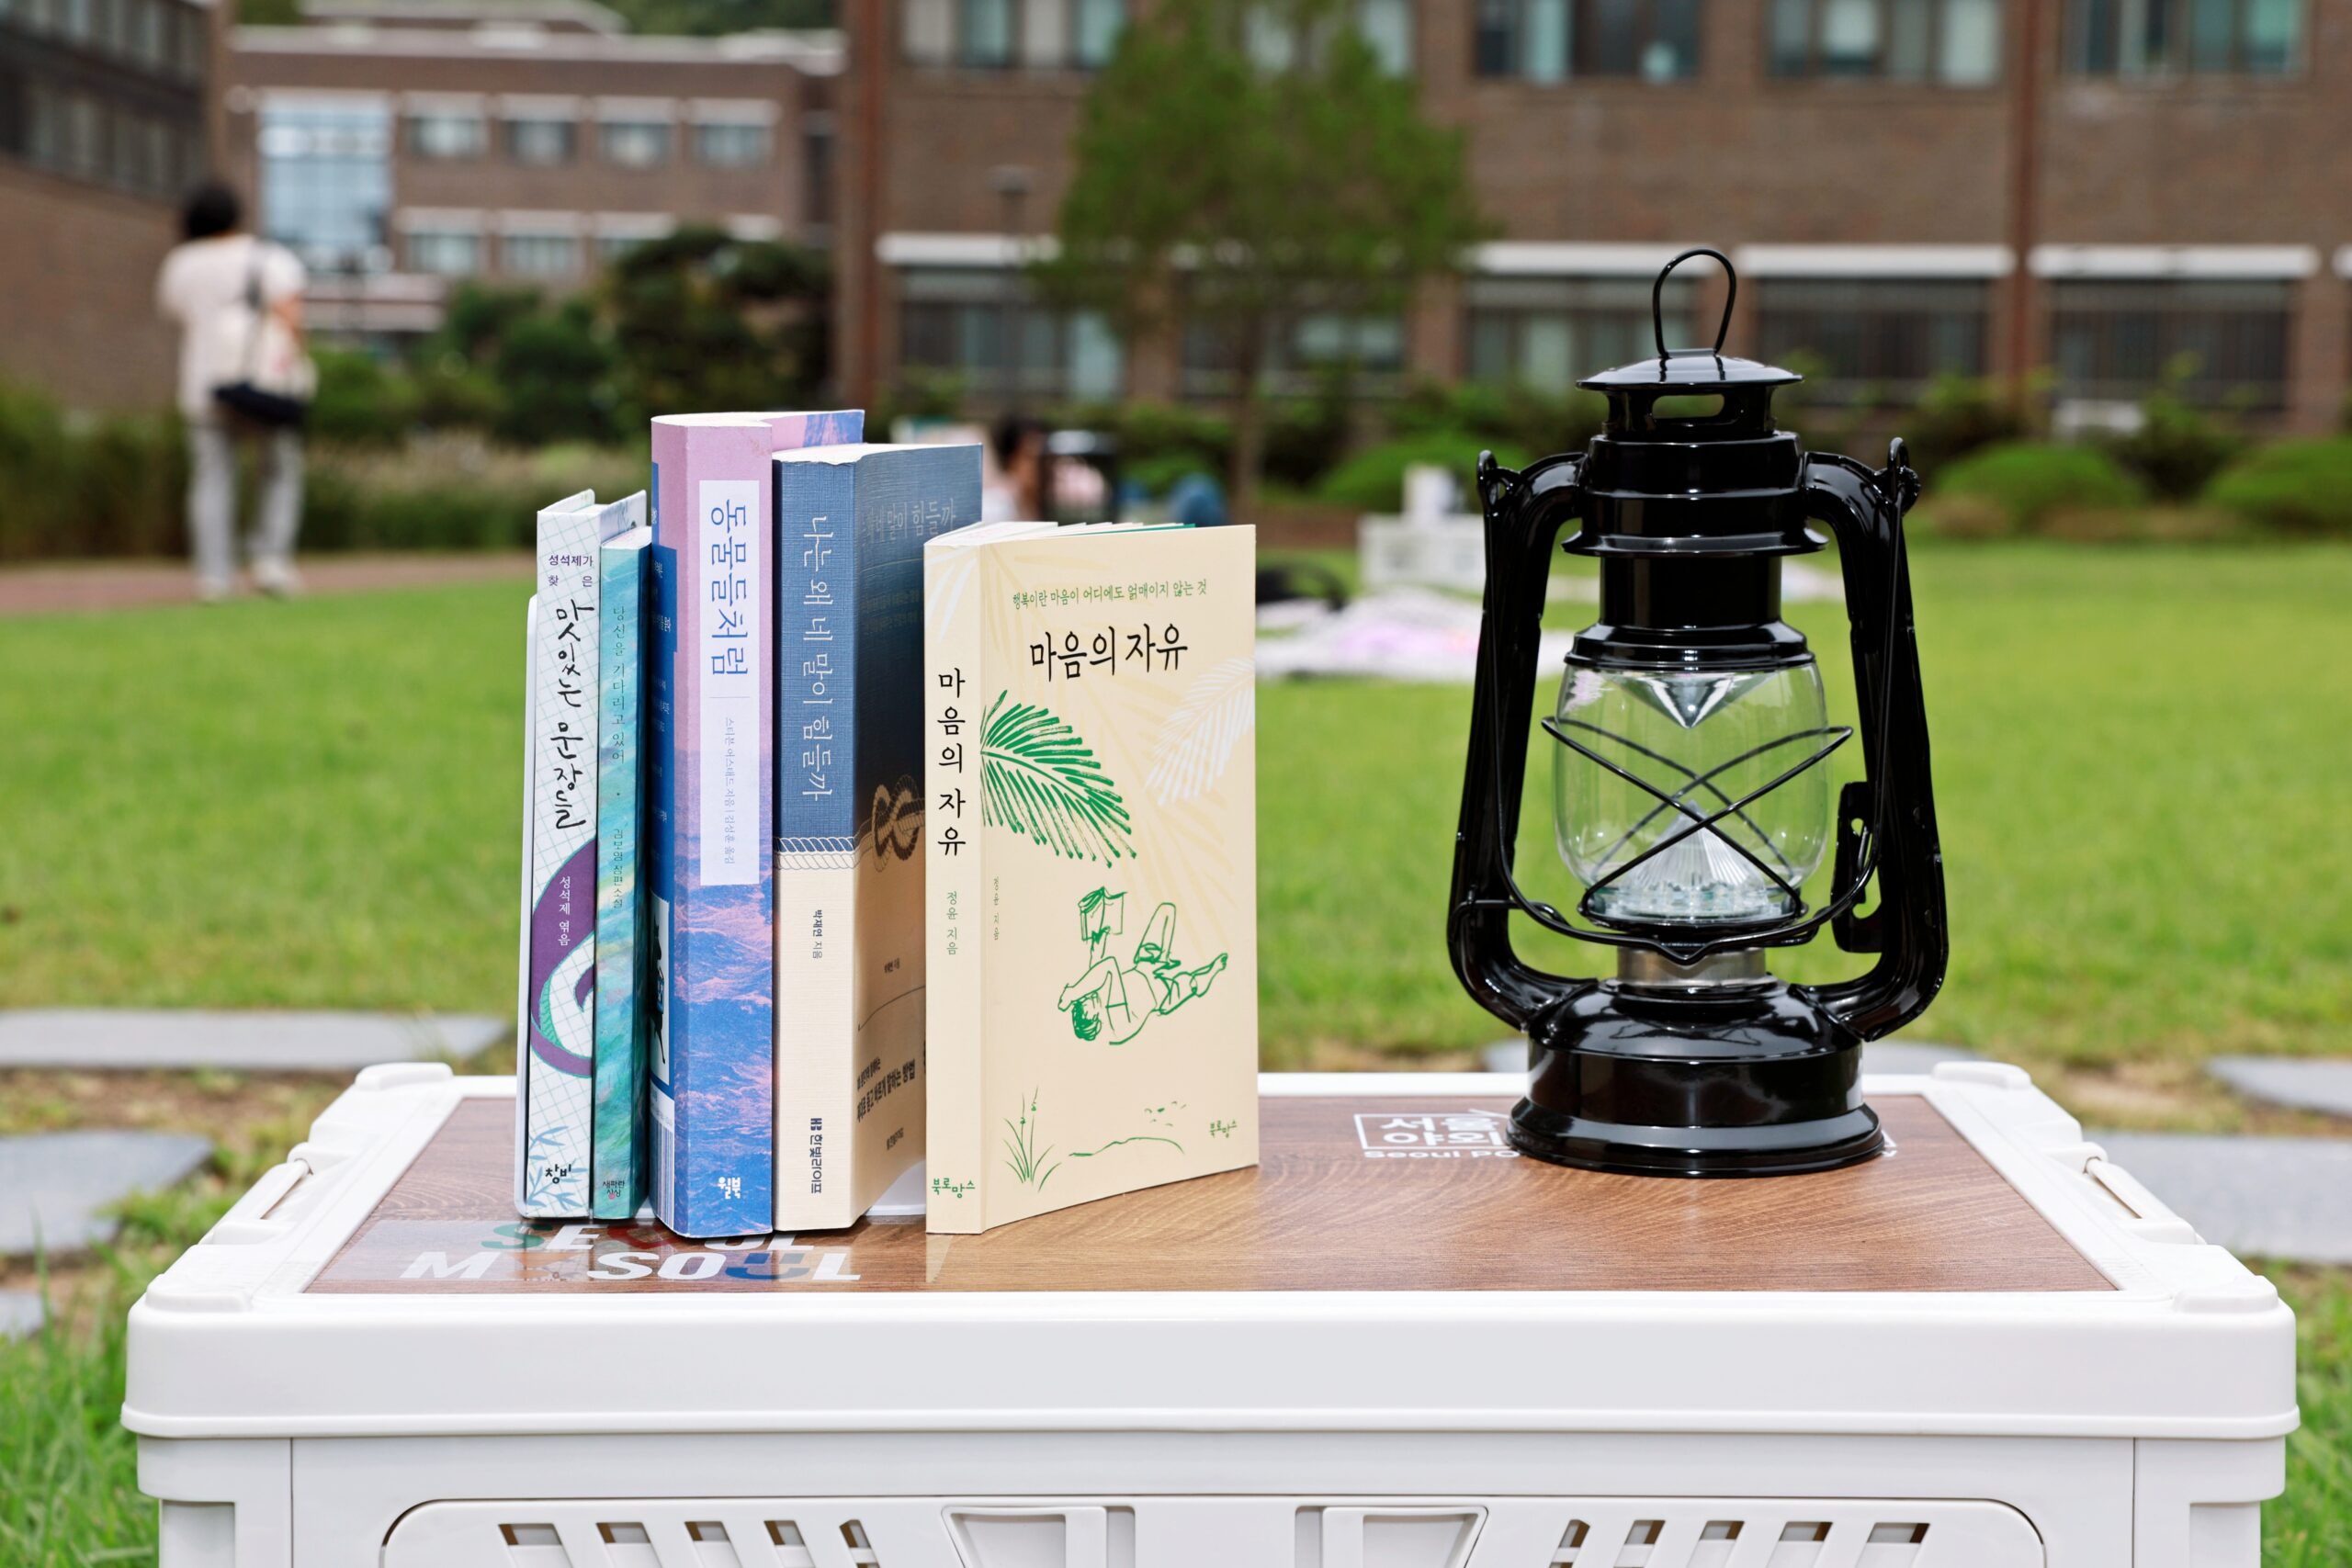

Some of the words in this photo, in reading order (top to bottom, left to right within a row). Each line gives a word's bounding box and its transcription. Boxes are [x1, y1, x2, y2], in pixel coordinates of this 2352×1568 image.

[887, 502, 908, 544] 말이
[911, 497, 956, 536] 힘들까
[804, 516, 833, 571] 나는
[548, 555, 593, 567] 성석제가
[711, 499, 748, 675] 동물들처럼
[804, 580, 833, 604] 왜
[1012, 590, 1047, 610] 행복이란
[1050, 587, 1079, 606] 마음이
[1083, 584, 1125, 603] 어디에도
[1127, 581, 1169, 601] 얽매이지
[1172, 580, 1193, 597] 않는
[1197, 579, 1207, 596] 것
[612, 606, 626, 656] 당신을
[804, 617, 833, 641] 네
[556, 599, 595, 707] 맛있는
[1030, 626, 1115, 682] 마음의
[1125, 623, 1188, 672] 자유
[803, 653, 832, 704] 말이
[612, 663, 626, 725] 기다리고
[937, 668, 966, 773] 마음의
[612, 732, 625, 763] 있어
[802, 716, 832, 801] 힘들까
[550, 722, 587, 829] 문장들
[724, 789, 735, 807] 지음
[937, 788, 966, 856] 자유
[724, 846, 735, 864] 옮김
[559, 876, 571, 914] 성석제
[558, 920, 571, 946] 엮음
[812, 909, 823, 937] 박재연
[812, 941, 823, 959] 지음
[946, 927, 958, 955] 지음
[1380, 1116, 1499, 1132] 서울
[1383, 1131, 1504, 1146] 야외
[809, 1134, 823, 1193] 한빛라이프
[1364, 1150, 1461, 1158] Seoul
[546, 1164, 571, 1184] 창비
[602, 1180, 625, 1189] 새파란
[718, 1177, 741, 1199] 윌북
[931, 1178, 976, 1199] 북로망스
[587, 1251, 862, 1280] SOUL
